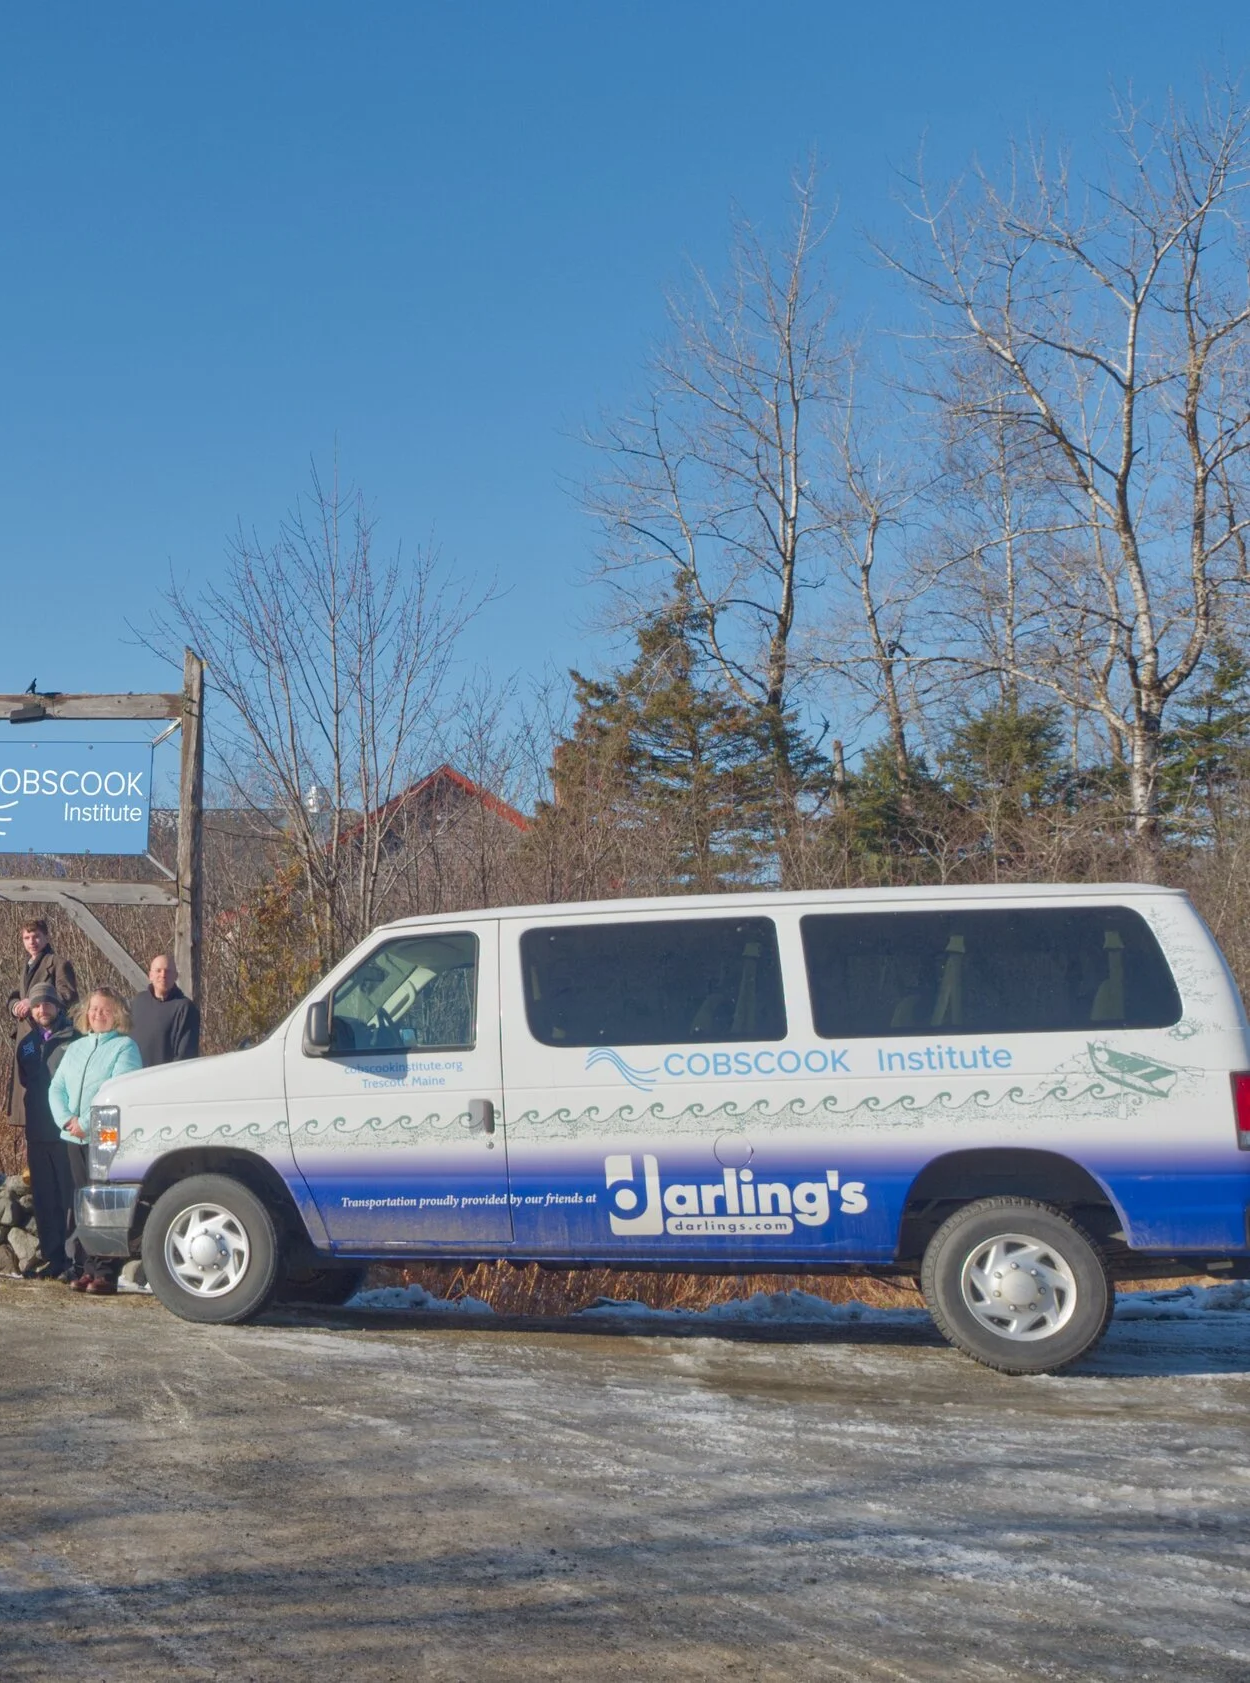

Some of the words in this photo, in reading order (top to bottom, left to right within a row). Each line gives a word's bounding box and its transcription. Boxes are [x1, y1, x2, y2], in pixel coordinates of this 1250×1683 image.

[64, 802, 142, 822] Institute
[344, 1061, 464, 1075] cobscookinstitute.org
[663, 1049, 852, 1076] COBSCOOK
[877, 1045, 1013, 1072] Institute
[412, 1075, 446, 1087] Maine
[341, 1196, 417, 1210] Transportation
[419, 1194, 459, 1209] proudly
[461, 1194, 508, 1208] provided
[510, 1193, 523, 1208] by
[525, 1196, 544, 1205] our
[544, 1192, 583, 1207] friends
[585, 1193, 597, 1204] at
[674, 1220, 788, 1233] darlings.com
